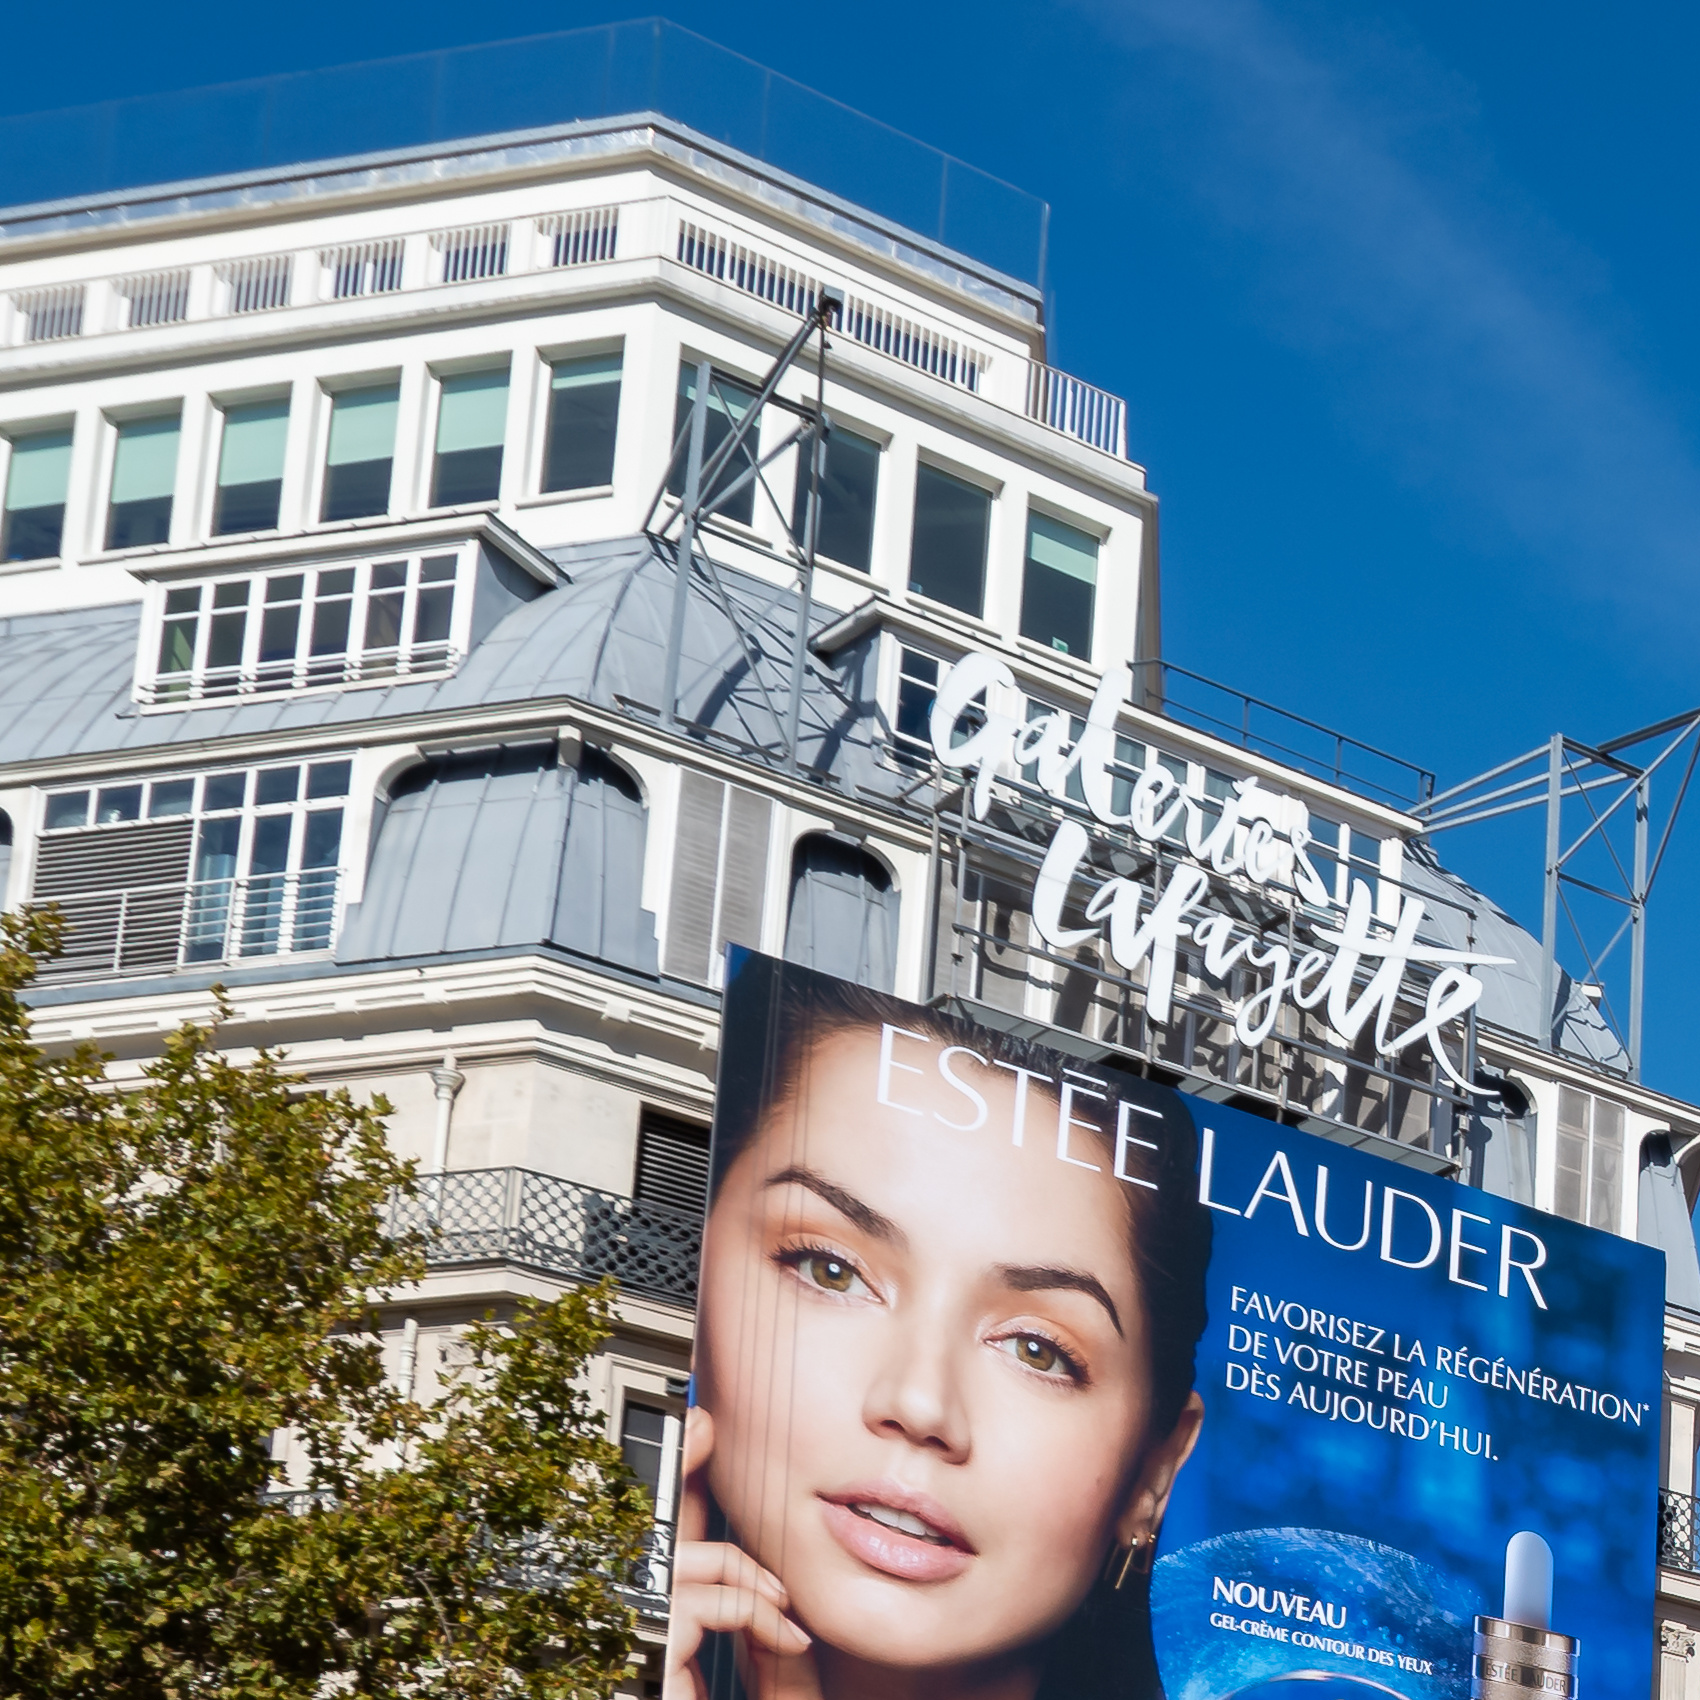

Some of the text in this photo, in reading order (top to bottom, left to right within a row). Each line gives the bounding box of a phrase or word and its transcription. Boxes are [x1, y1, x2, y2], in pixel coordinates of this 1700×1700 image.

[930, 651, 1329, 908] Galeries
[1032, 821, 1516, 1096] Lafayette
[1200, 1127, 1548, 1310] LAUDER
[1228, 1324, 1448, 1409] DE VOTRE PEAU
[1231, 1285, 1386, 1356] FAVORISEZ
[1394, 1334, 1426, 1366] LA
[1225, 1362, 1499, 1461] DÈS AUJOURD'HUI.
[1210, 1612, 1434, 1676] GEL-CRÈME CONTOUR DES YEUX
[1212, 1576, 1347, 1630] NOUVEAU
[1522, 1669, 1567, 1693] LAUDER
